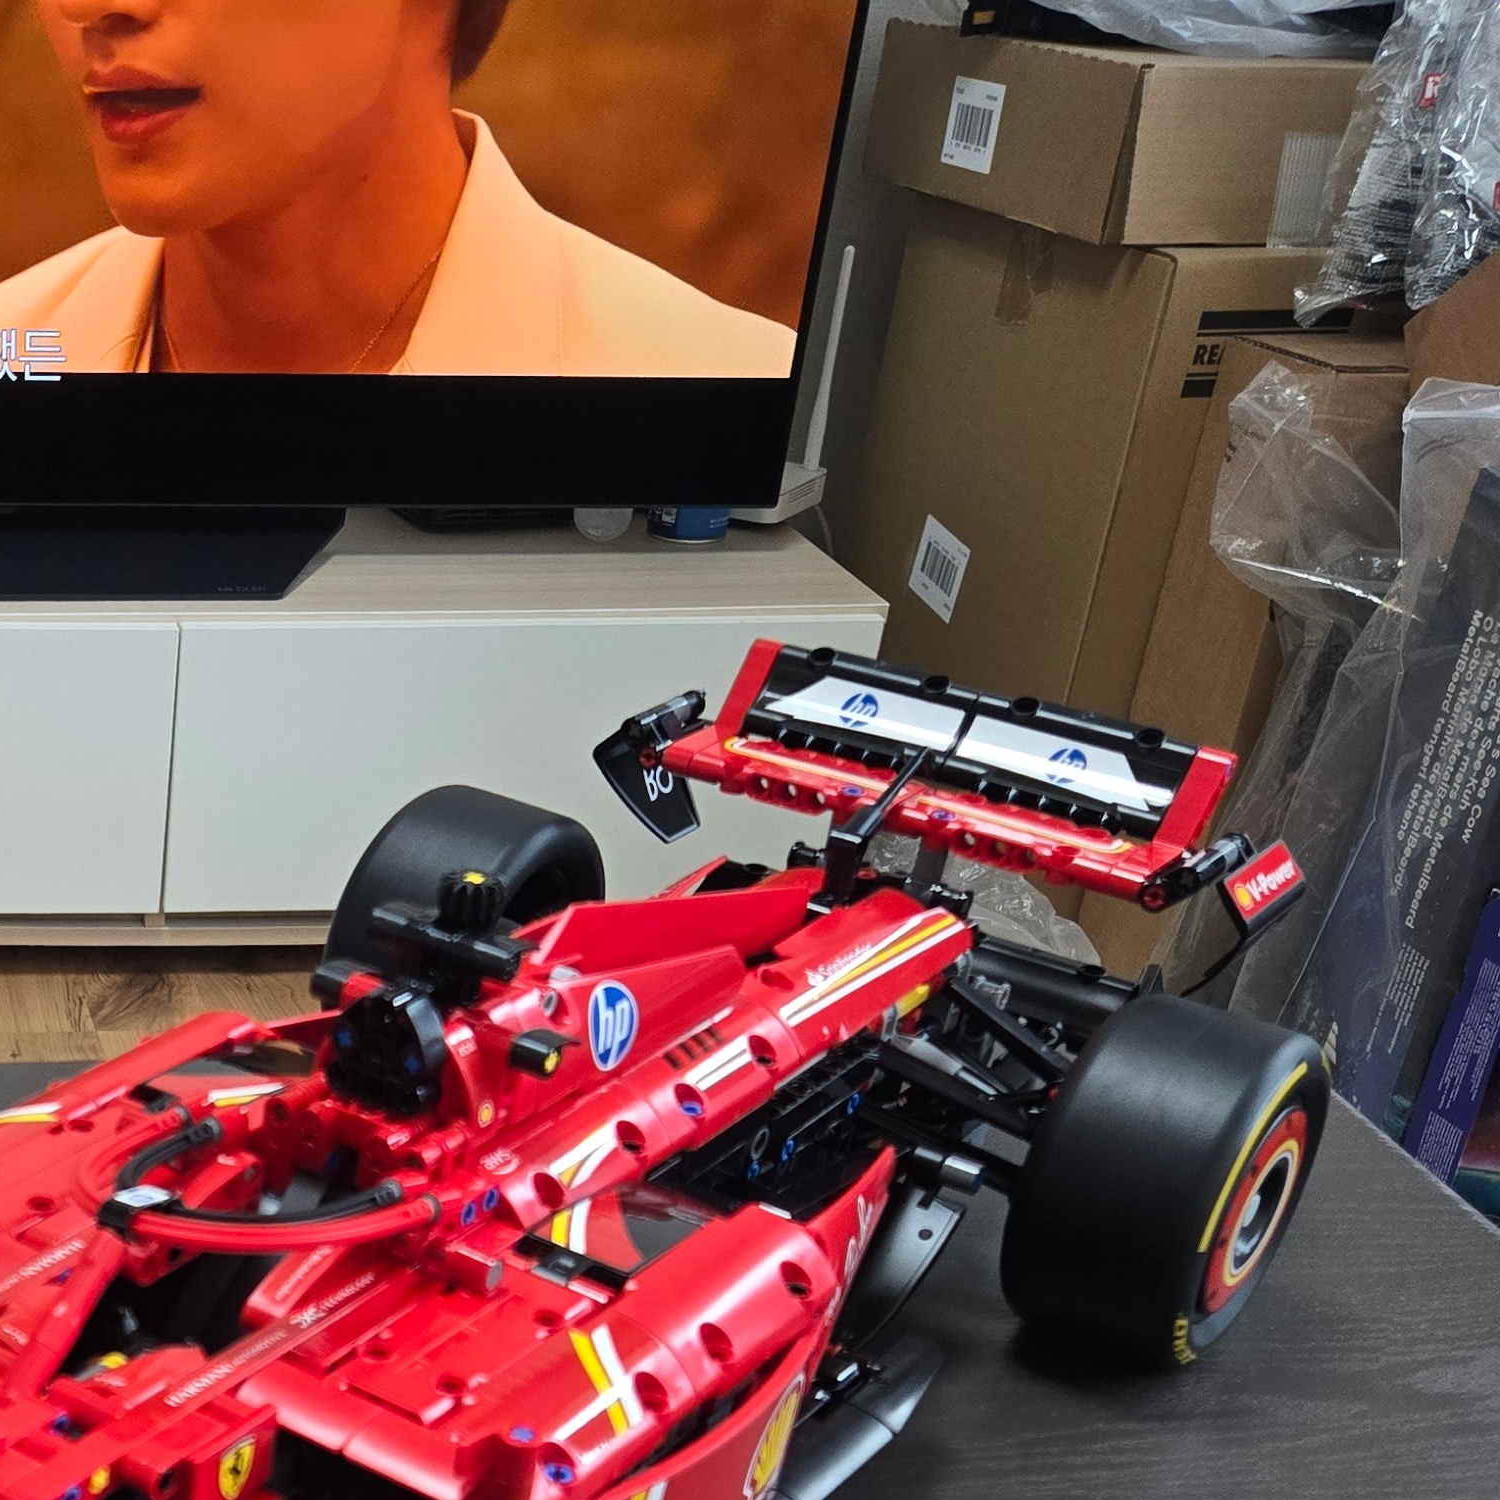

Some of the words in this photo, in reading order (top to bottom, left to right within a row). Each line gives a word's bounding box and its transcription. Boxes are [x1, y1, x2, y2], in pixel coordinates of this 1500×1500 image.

[1465, 636, 1488, 682] Lobo
[1459, 710, 1474, 735] de
[1467, 717, 1485, 751] des
[1423, 739, 1466, 839] MetalBeard
[1428, 762, 1441, 785] de
[1449, 755, 1471, 800] mers
[1458, 736, 1493, 811] See-Kuh
[1477, 763, 1497, 799] Sea
[1439, 804, 1453, 828] de
[1461, 804, 1483, 844] Cow
[1245, 858, 1297, 902] V-Power
[1404, 832, 1446, 929] MetalBeard
[591, 987, 635, 1065] hp
